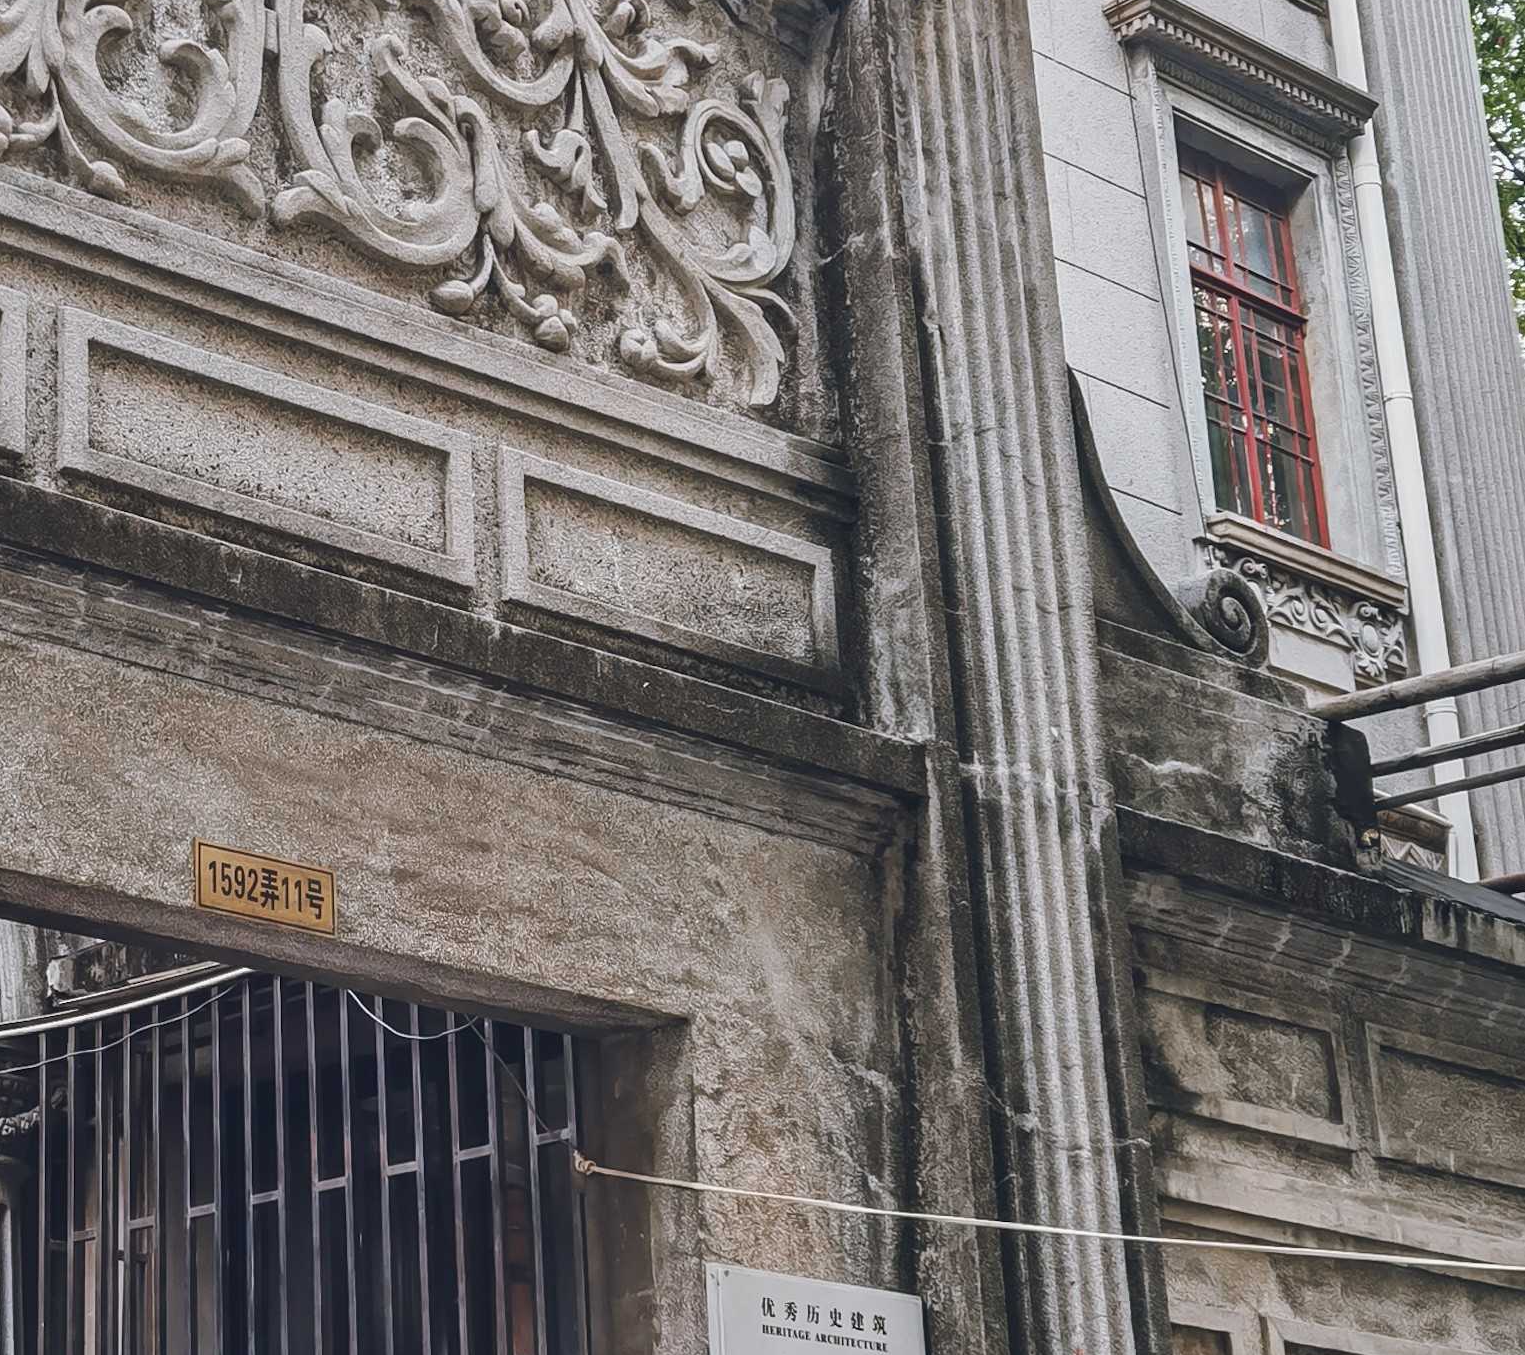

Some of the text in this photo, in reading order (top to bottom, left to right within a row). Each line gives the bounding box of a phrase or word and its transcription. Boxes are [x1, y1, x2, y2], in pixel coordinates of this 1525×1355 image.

[208, 860, 324, 920] 1592弄11号
[762, 1297, 887, 1335] 优秀历史建筑
[762, 1324, 888, 1353] HERITAGE ARCHITECTURE
